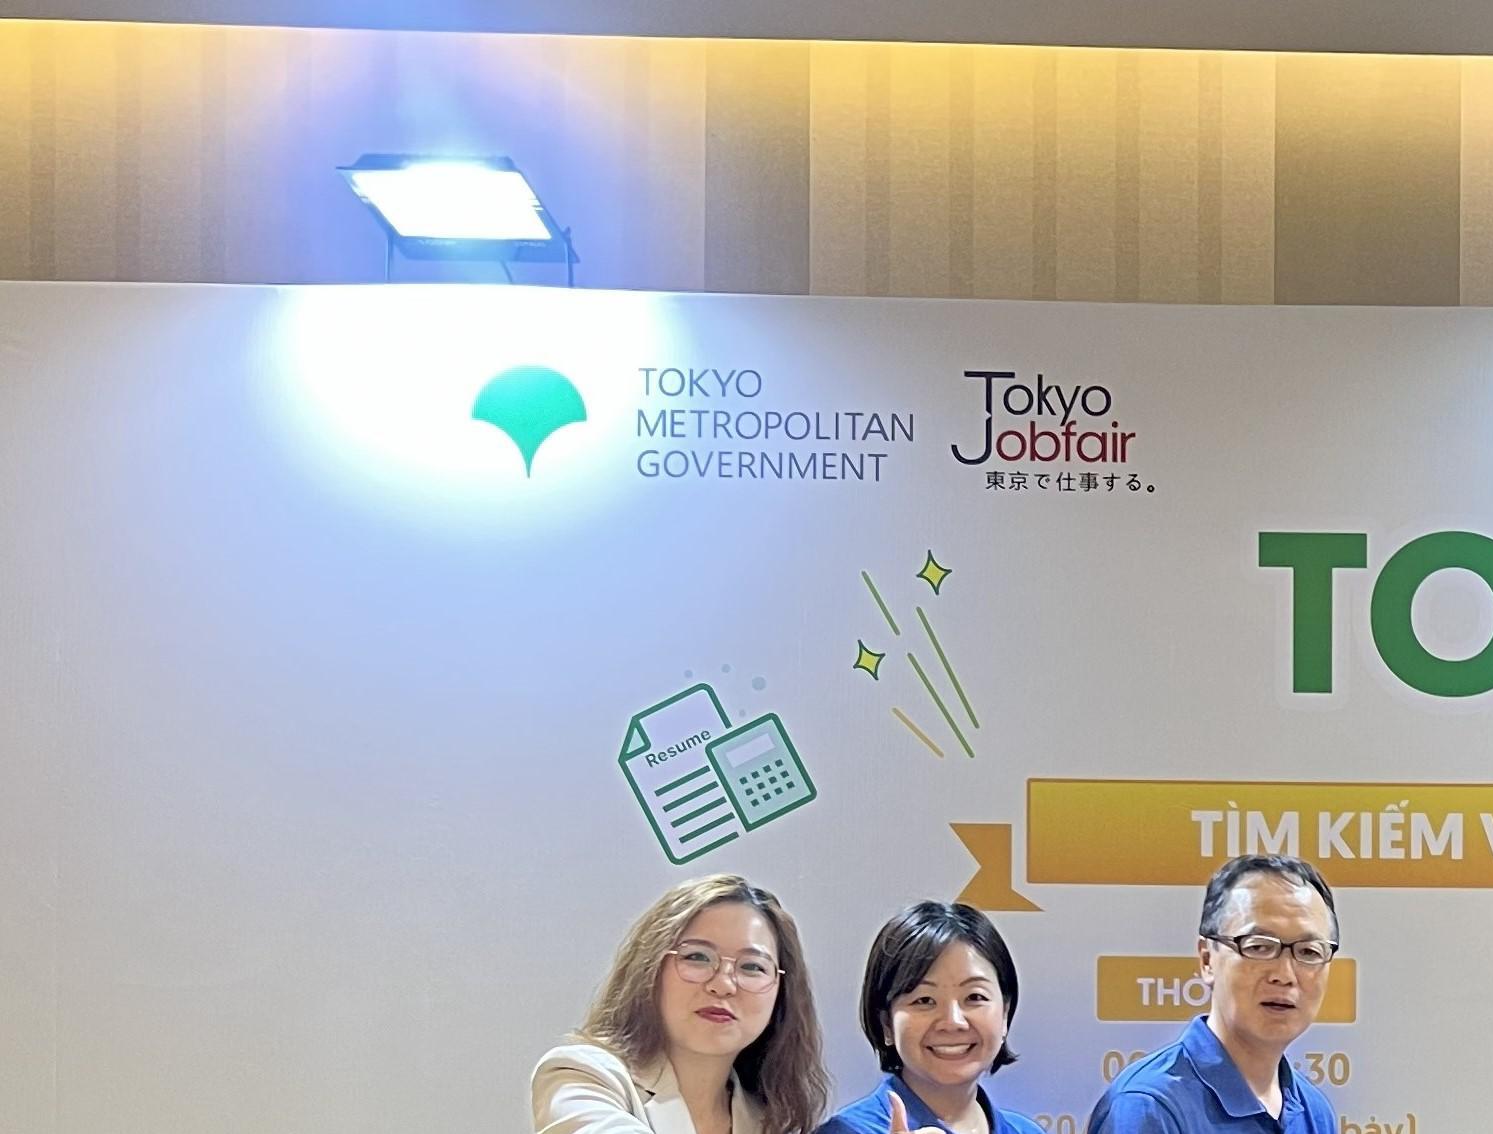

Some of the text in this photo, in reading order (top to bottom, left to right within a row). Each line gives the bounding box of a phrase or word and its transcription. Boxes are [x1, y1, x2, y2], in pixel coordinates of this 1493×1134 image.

[638, 367, 762, 398] TOKYO
[963, 370, 1112, 427] Tokyo
[636, 408, 914, 442] METROPOLITAN
[951, 420, 1136, 465] Jobfair
[636, 449, 888, 482] GOVERNMENT
[985, 470, 1155, 493] 東京で仕事する。
[645, 728, 712, 769] Resume
[1191, 800, 1300, 860] TÌM
[1318, 799, 1464, 861] KIẾM
